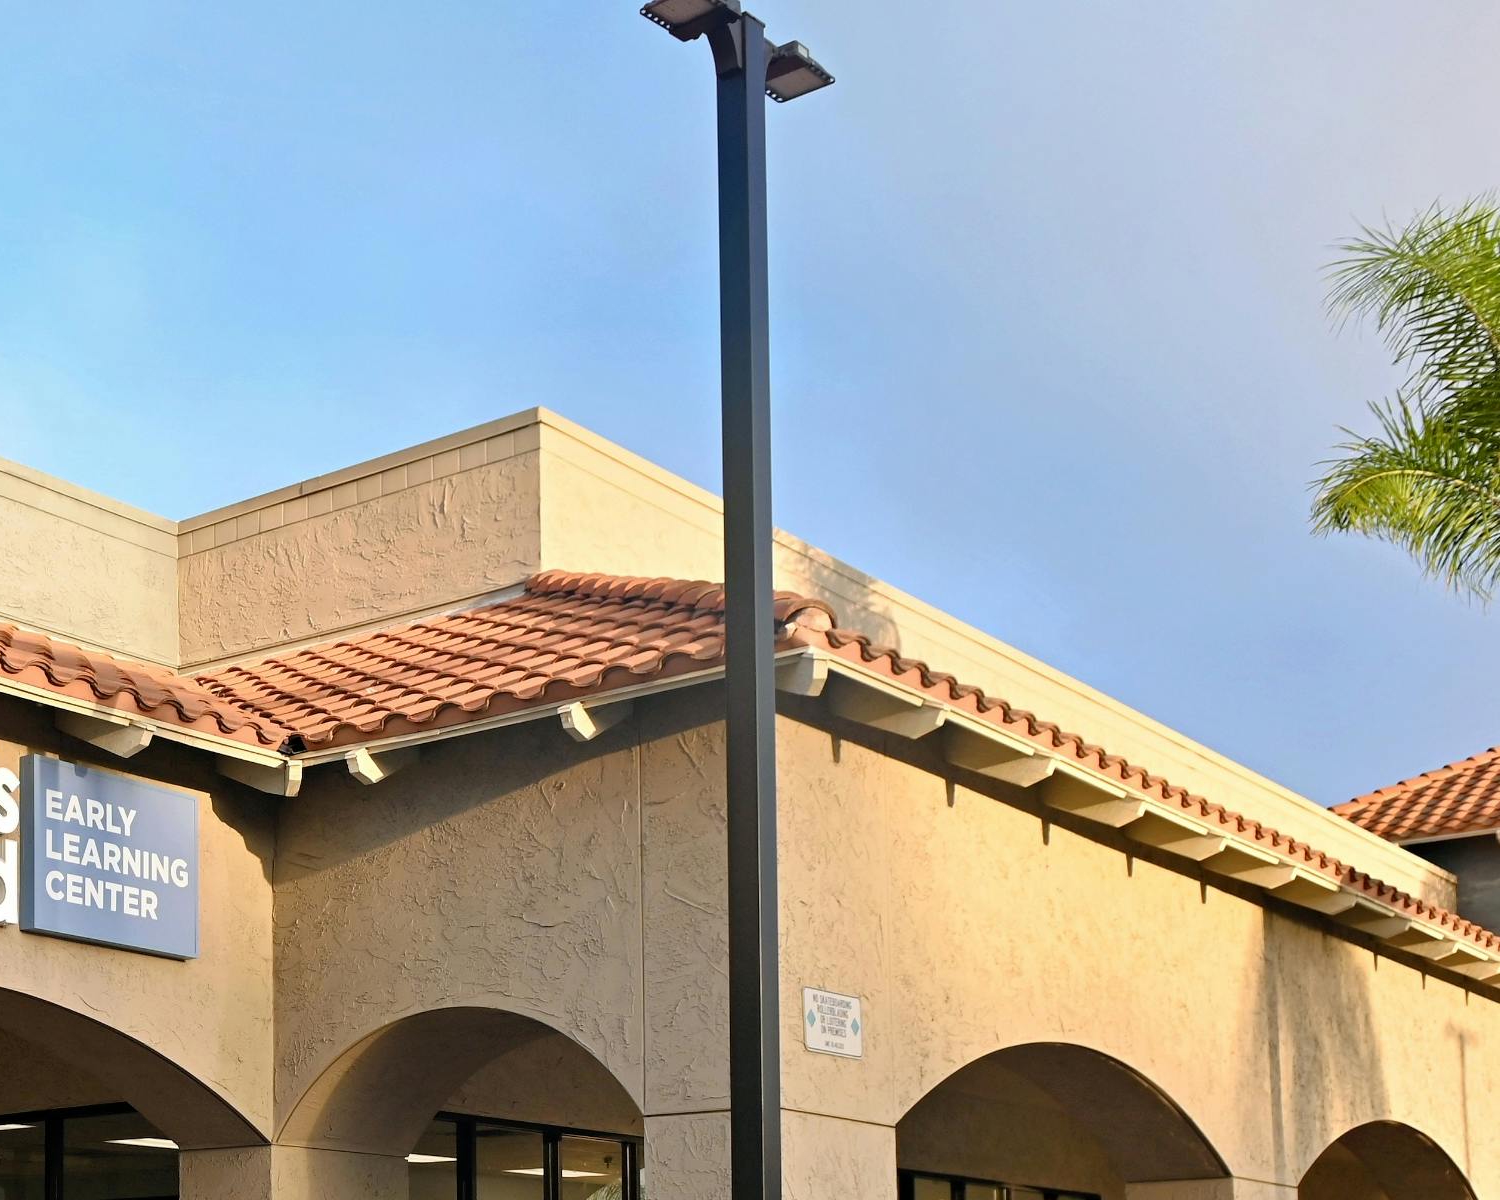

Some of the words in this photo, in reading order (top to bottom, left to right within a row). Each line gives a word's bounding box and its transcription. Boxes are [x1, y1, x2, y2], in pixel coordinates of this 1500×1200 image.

[45, 788, 137, 837] EARLY
[45, 828, 189, 889] LEARNING
[45, 869, 158, 921] CENTER
